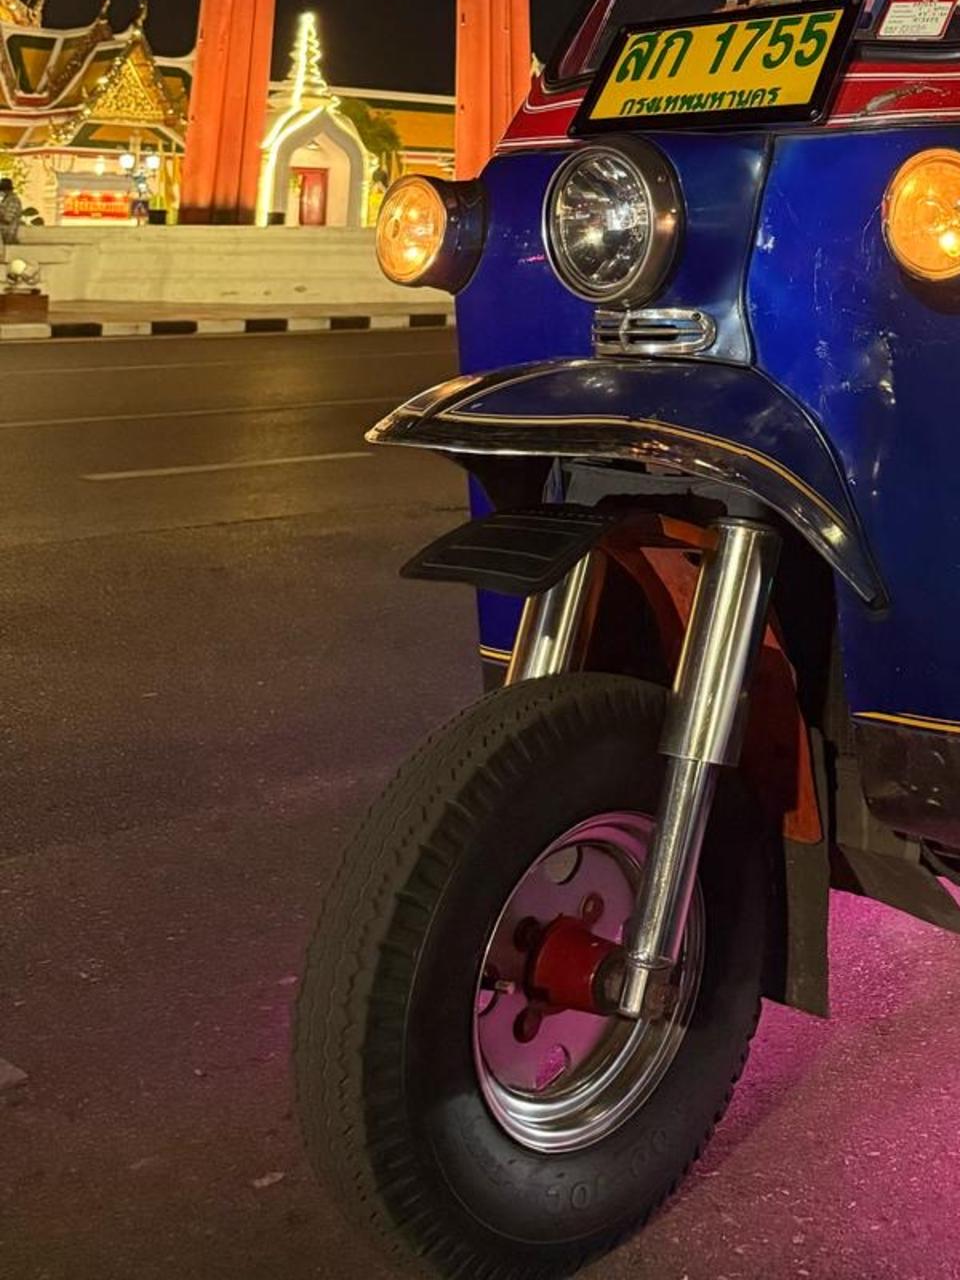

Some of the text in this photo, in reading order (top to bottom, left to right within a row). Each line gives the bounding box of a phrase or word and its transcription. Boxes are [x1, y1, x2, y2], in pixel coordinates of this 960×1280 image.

[615, 30, 694, 82] สก
[708, 12, 836, 74] 1755
[619, 87, 782, 115] กรงเทพมหานคร
